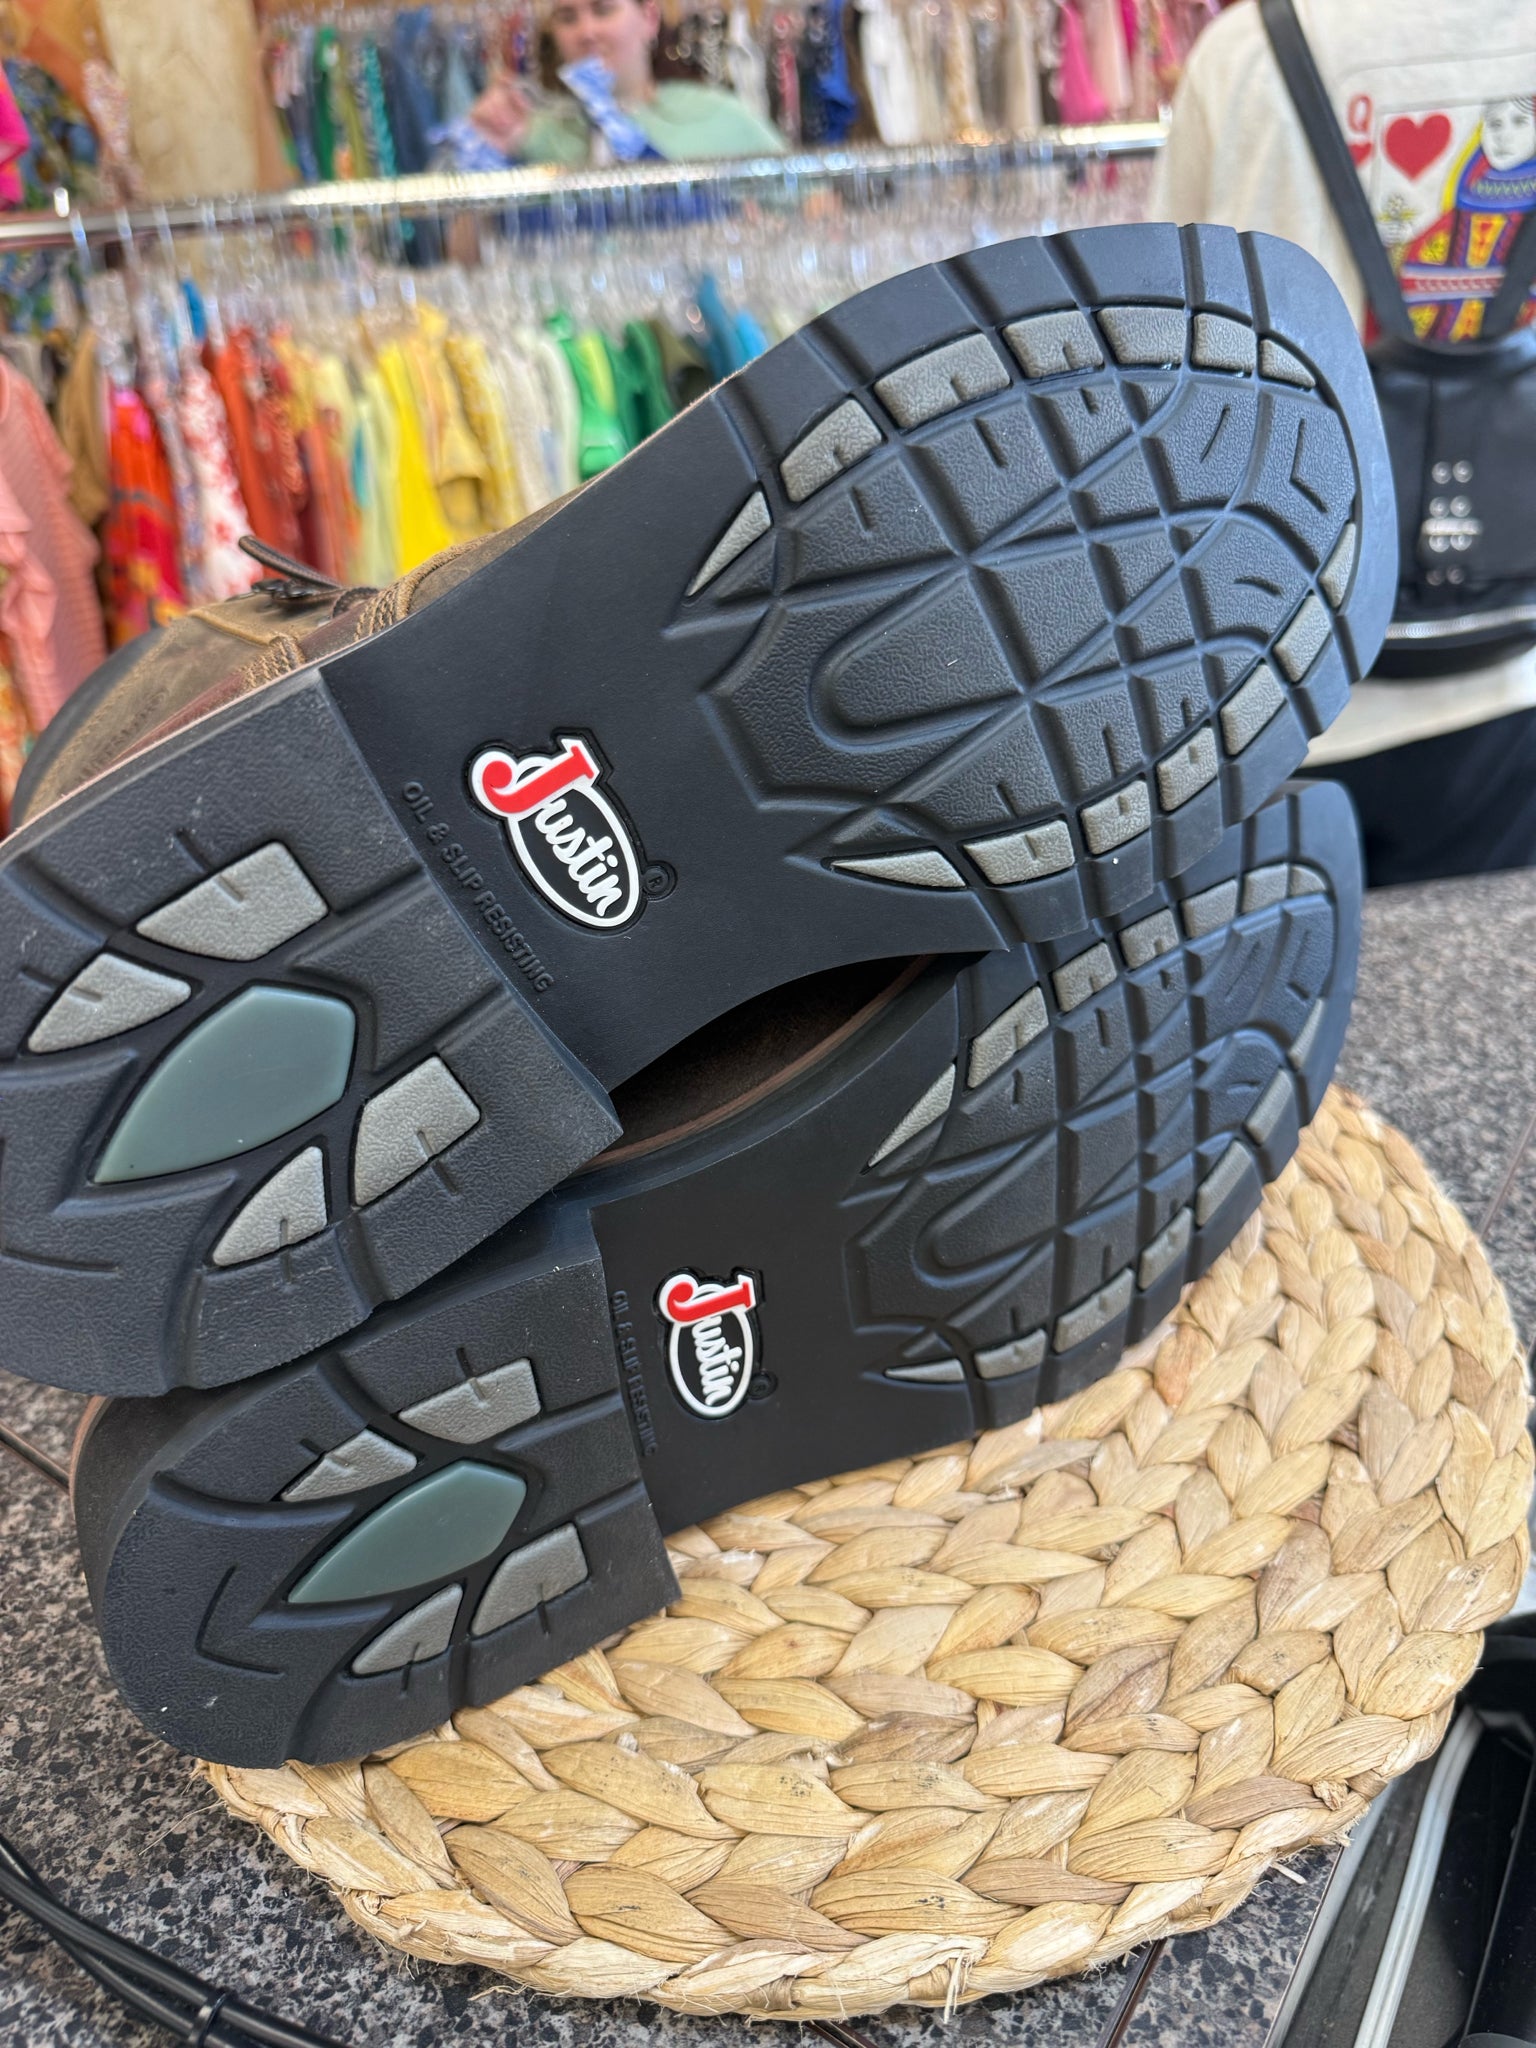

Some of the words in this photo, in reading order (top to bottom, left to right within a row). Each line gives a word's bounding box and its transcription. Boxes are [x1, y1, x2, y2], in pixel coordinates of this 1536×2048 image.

[1347, 94, 1373, 132] Q
[403, 781, 434, 822] OIL
[427, 822, 451, 845] &
[440, 842, 485, 891] SLIP
[474, 889, 556, 993] RESISTING
[472, 738, 624, 917] Justin
[659, 1273, 757, 1406] Justin
